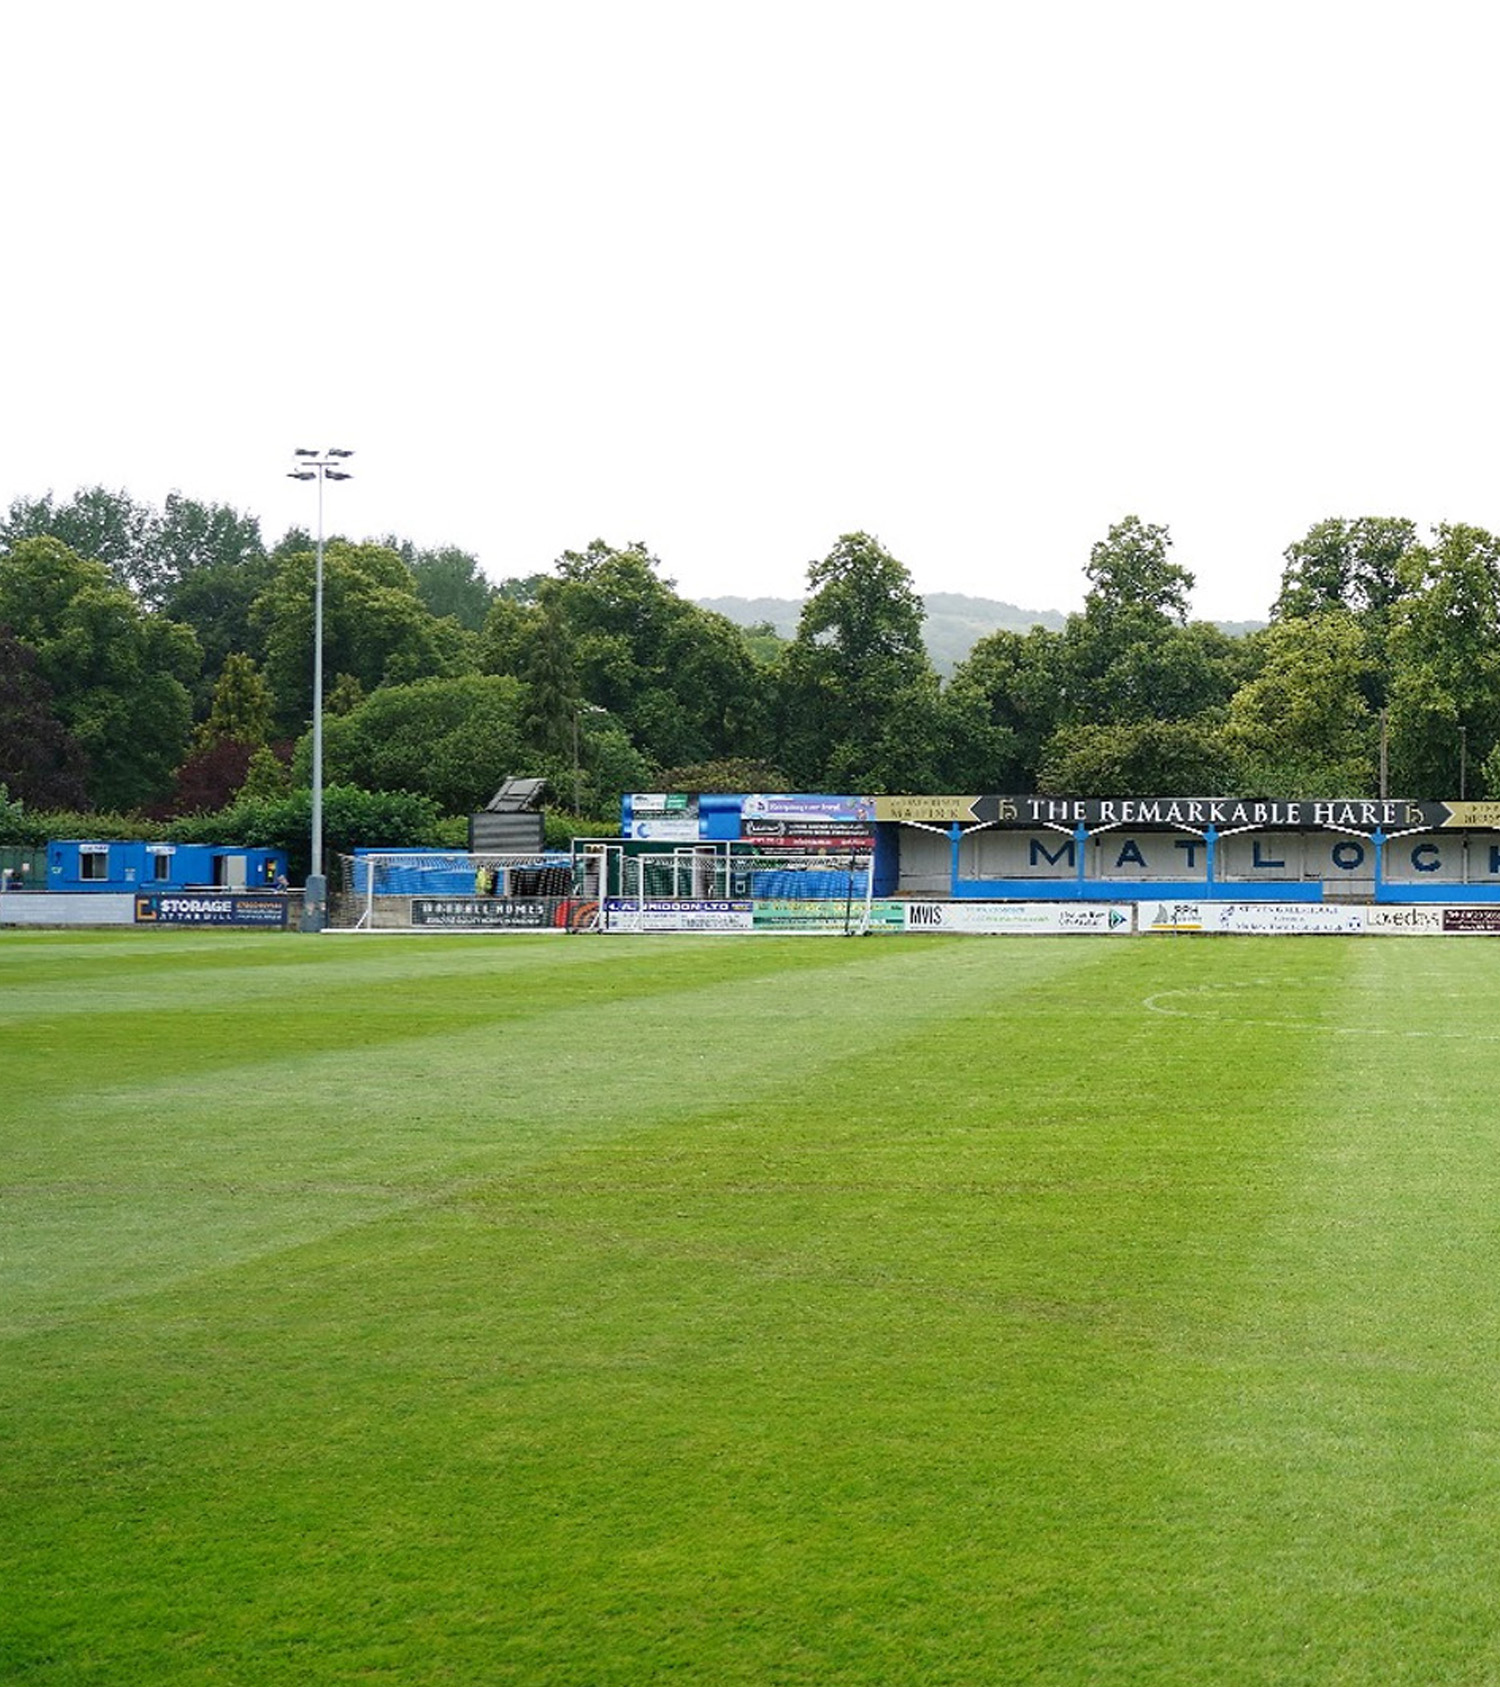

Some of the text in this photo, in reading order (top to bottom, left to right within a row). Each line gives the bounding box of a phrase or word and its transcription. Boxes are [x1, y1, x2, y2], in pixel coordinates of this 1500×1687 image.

[1027, 801, 1396, 824] THE REMARKABLE HARE
[160, 899, 232, 912] STORAGE
[909, 905, 942, 925] MVIS
